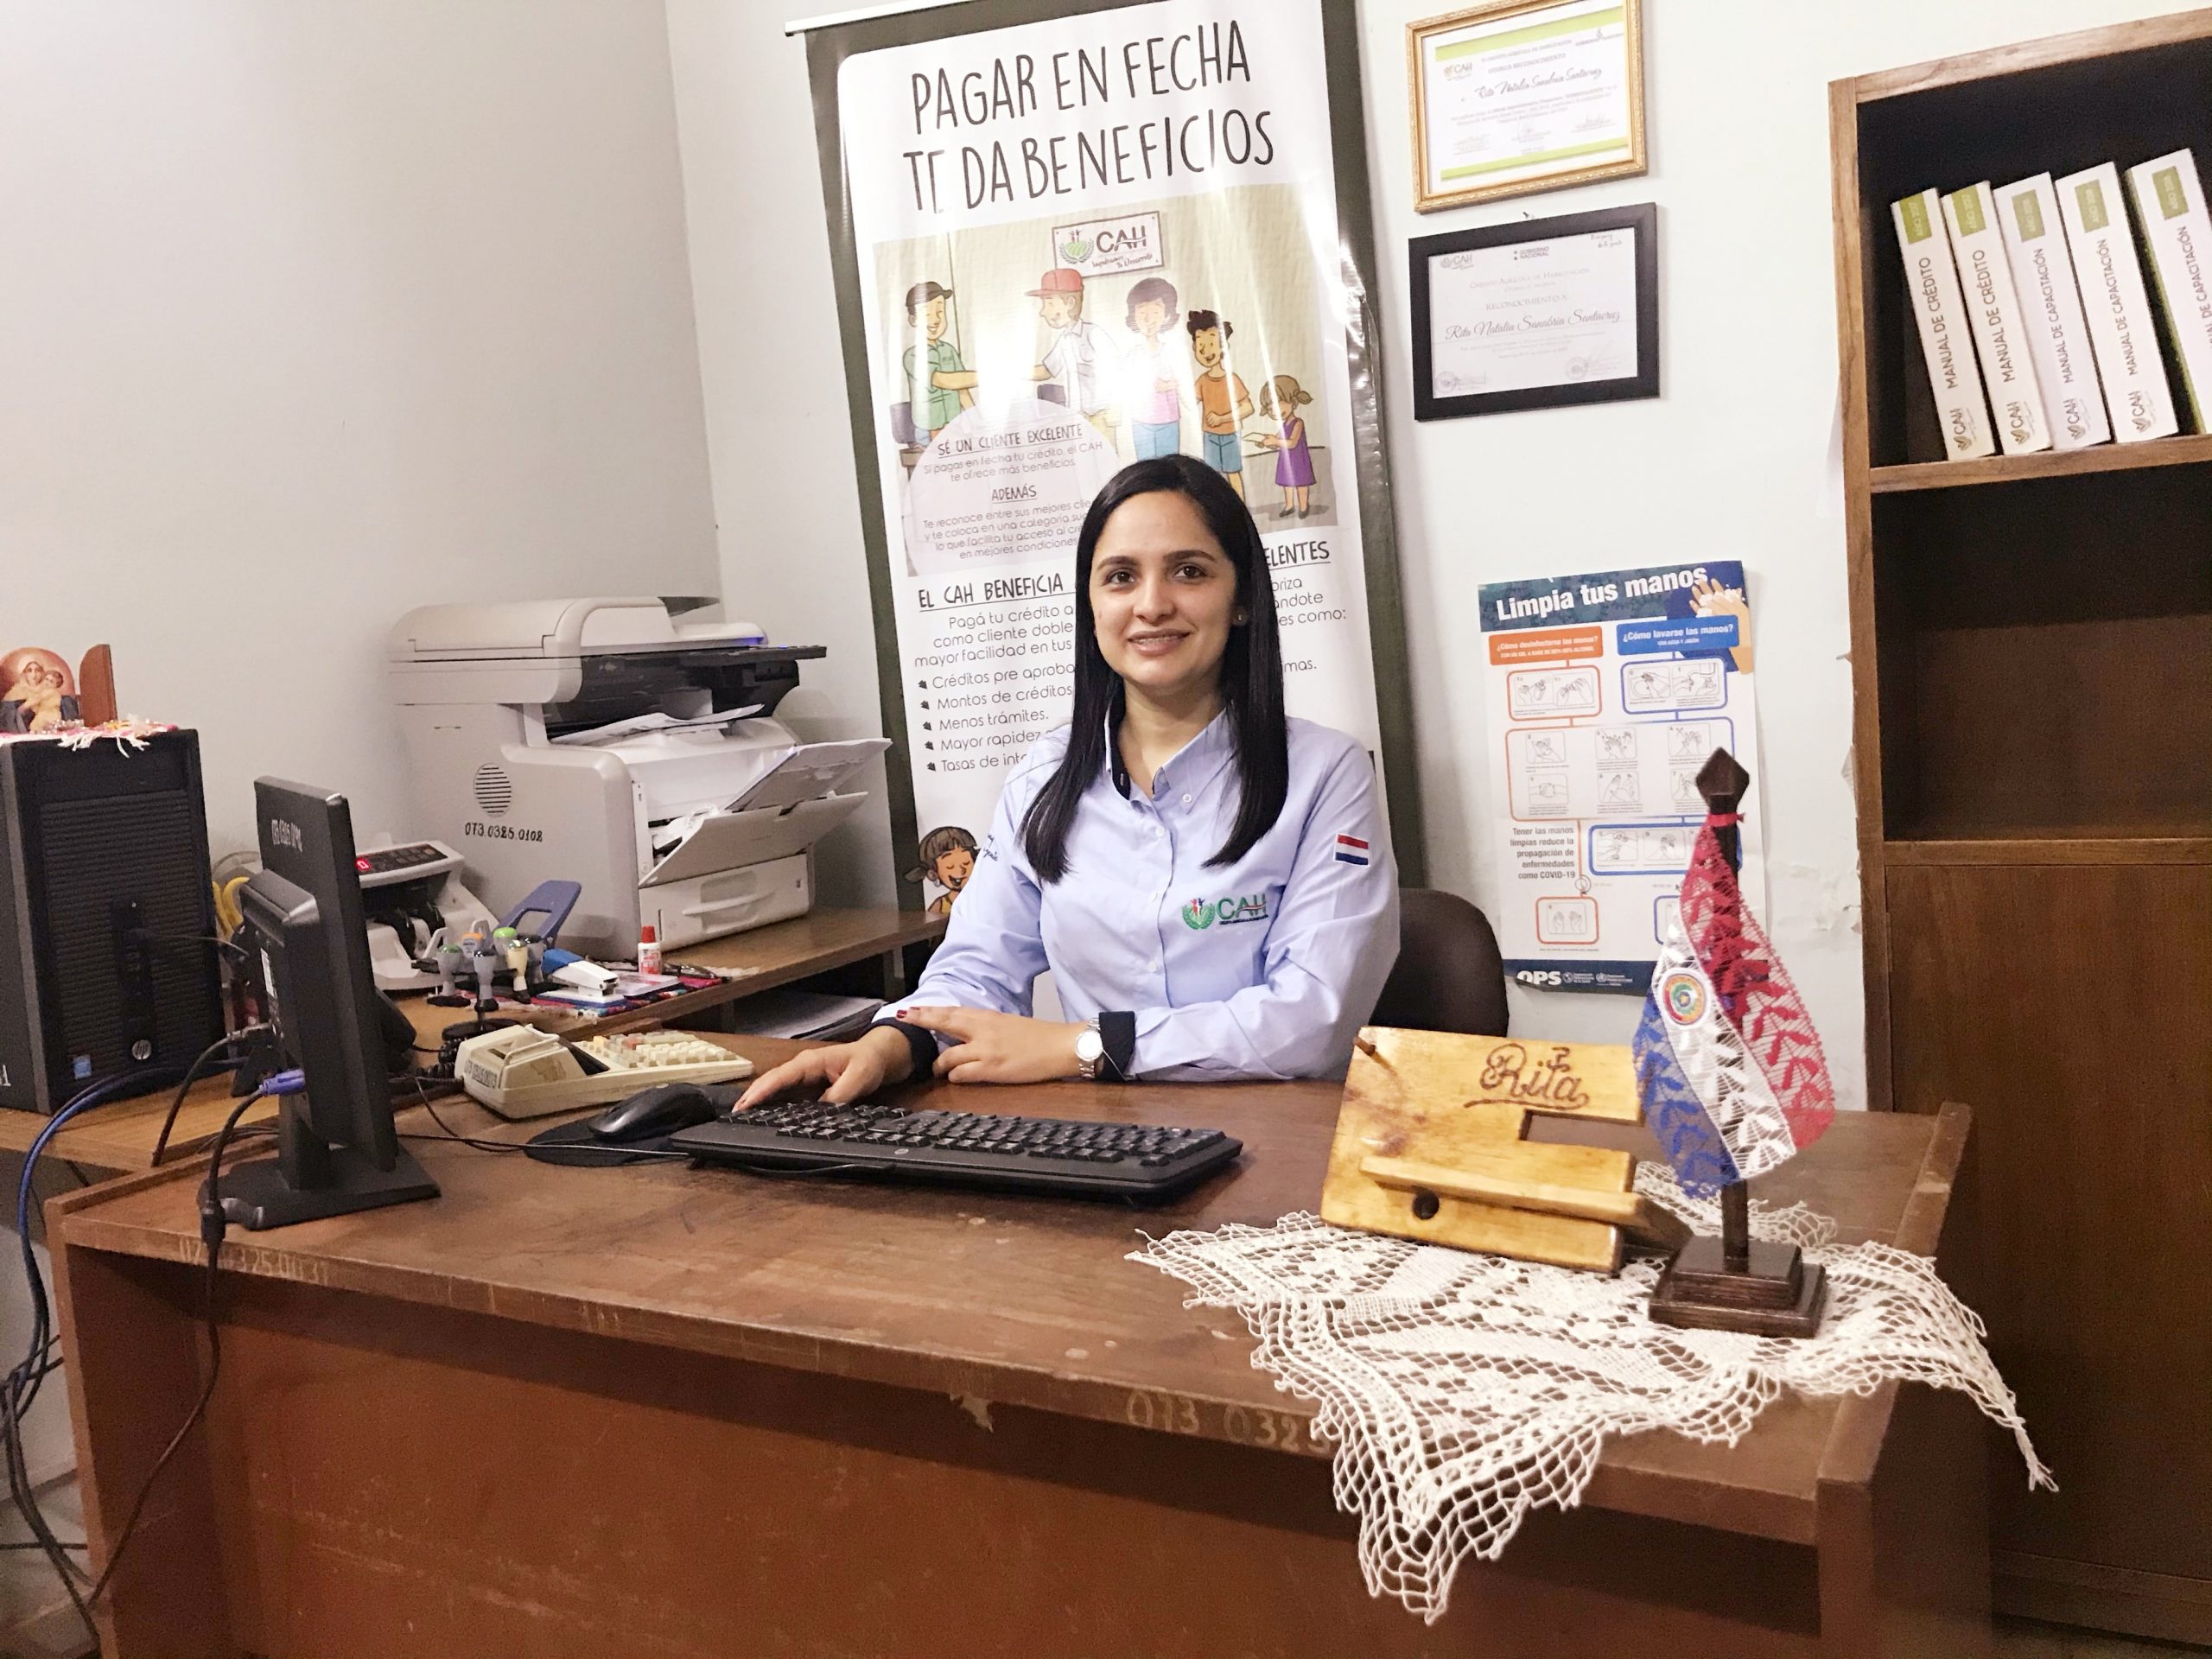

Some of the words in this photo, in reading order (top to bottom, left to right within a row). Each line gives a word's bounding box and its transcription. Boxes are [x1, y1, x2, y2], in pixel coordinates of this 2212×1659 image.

[911, 54, 1038, 135] PAGAR
[1052, 46, 1109, 111] EN
[1122, 20, 1251, 99] FECHA
[962, 141, 1014, 209] DA
[1021, 109, 1274, 198] BENEFICIOS
[1096, 226, 1147, 253] CAH
[1972, 250, 1995, 305] CRÉDITO
[2095, 238, 2124, 315] CAPACITACIÓN
[2177, 225, 2209, 305] CAPACITACIÓN
[1918, 257, 1940, 312] CRÉDITO
[2033, 247, 2058, 323] CAPACITACIÓN
[1931, 314, 1945, 334] DE
[1986, 307, 2002, 327] DE
[2051, 323, 2064, 339] DE
[2114, 315, 2127, 330] DE
[1936, 334, 1959, 390] MANUAL
[1992, 327, 2016, 384] MANUAL
[2055, 339, 2075, 385] MANUAL
[2119, 330, 2139, 376] MANUAL
[1949, 408, 1967, 435] CAH
[2005, 401, 2024, 429] CAH
[938, 439, 951, 455] SÉ
[956, 437, 973, 453] UN
[977, 431, 1020, 448] CLIENTE
[1027, 423, 1084, 443] EXCELENTE
[933, 461, 963, 476] pagas
[965, 457, 980, 467] en
[980, 453, 1013, 466] fecha
[1014, 451, 1026, 461] tu
[1067, 443, 1077, 454] el
[1078, 440, 1103, 453] CAH
[950, 471, 961, 482] te
[963, 467, 995, 481] ofrece
[998, 462, 1020, 475] más
[991, 483, 1038, 501] ADEMÁS
[923, 519, 934, 530] Te
[936, 512, 983, 528] reconoce
[985, 509, 1013, 522] entre
[1014, 507, 1030, 518] sus
[1032, 502, 1071, 517] mejores
[1073, 499, 1092, 512] clie
[931, 530, 943, 540] te
[944, 525, 980, 539] coloca
[982, 523, 995, 534] en
[996, 520, 1018, 532] una
[935, 542, 945, 552] lo
[946, 539, 963, 554] que
[964, 533, 1001, 550] facilita
[1002, 532, 1014, 543] tu
[1015, 528, 1054, 542] acceso
[1055, 526, 1066, 537] al
[958, 550, 973, 560] en
[974, 544, 1014, 560] mejores
[1263, 540, 1331, 568] ELENTES
[918, 588, 935, 609] EL
[944, 582, 975, 605] CAH
[983, 573, 1065, 601] BENEFICIA
[1271, 577, 1303, 593] oriza
[1496, 588, 1575, 621] Limpia
[1580, 581, 1618, 606] tus
[1624, 566, 1708, 599] manos
[949, 613, 987, 631] Pagá
[988, 611, 1005, 624] tu
[1007, 604, 1061, 623] crédito
[1063, 604, 1075, 616] a
[1297, 608, 1347, 624] como:
[932, 633, 975, 649] como
[977, 626, 1027, 644] cliente
[1032, 620, 1074, 638] doble
[1623, 630, 1651, 642] ¿Cómo
[1653, 628, 1684, 639] lavarse
[1685, 626, 1699, 636] las
[914, 652, 961, 669] mayor
[961, 642, 1027, 662] facilidad
[1030, 641, 1050, 655] en
[1051, 638, 1073, 652] tus
[931, 671, 990, 690] Créditos
[993, 669, 1020, 685] pre
[1022, 662, 1076, 682] aproba
[937, 693, 988, 711] Montos
[990, 690, 1013, 704] de
[1014, 683, 1073, 702] créditos
[939, 714, 985, 732] Menos
[987, 708, 1050, 730] trámites.
[940, 735, 984, 753] Mayor
[940, 756, 976, 773] Tasas
[979, 753, 1001, 768] de
[1510, 838, 1537, 848] limpias
[1539, 837, 1565, 846] reduce
[1512, 827, 1533, 836] Tener
[1548, 826, 1574, 835] manos
[1522, 860, 1575, 868] enfermedades
[1564, 848, 1574, 856] de
[1540, 870, 1576, 879] COVID-19
[1217, 893, 1267, 920] CAH
[1516, 970, 1562, 986] OPS
[1476, 1042, 1591, 1107] Rita
[1126, 1389, 1199, 1434] 013
